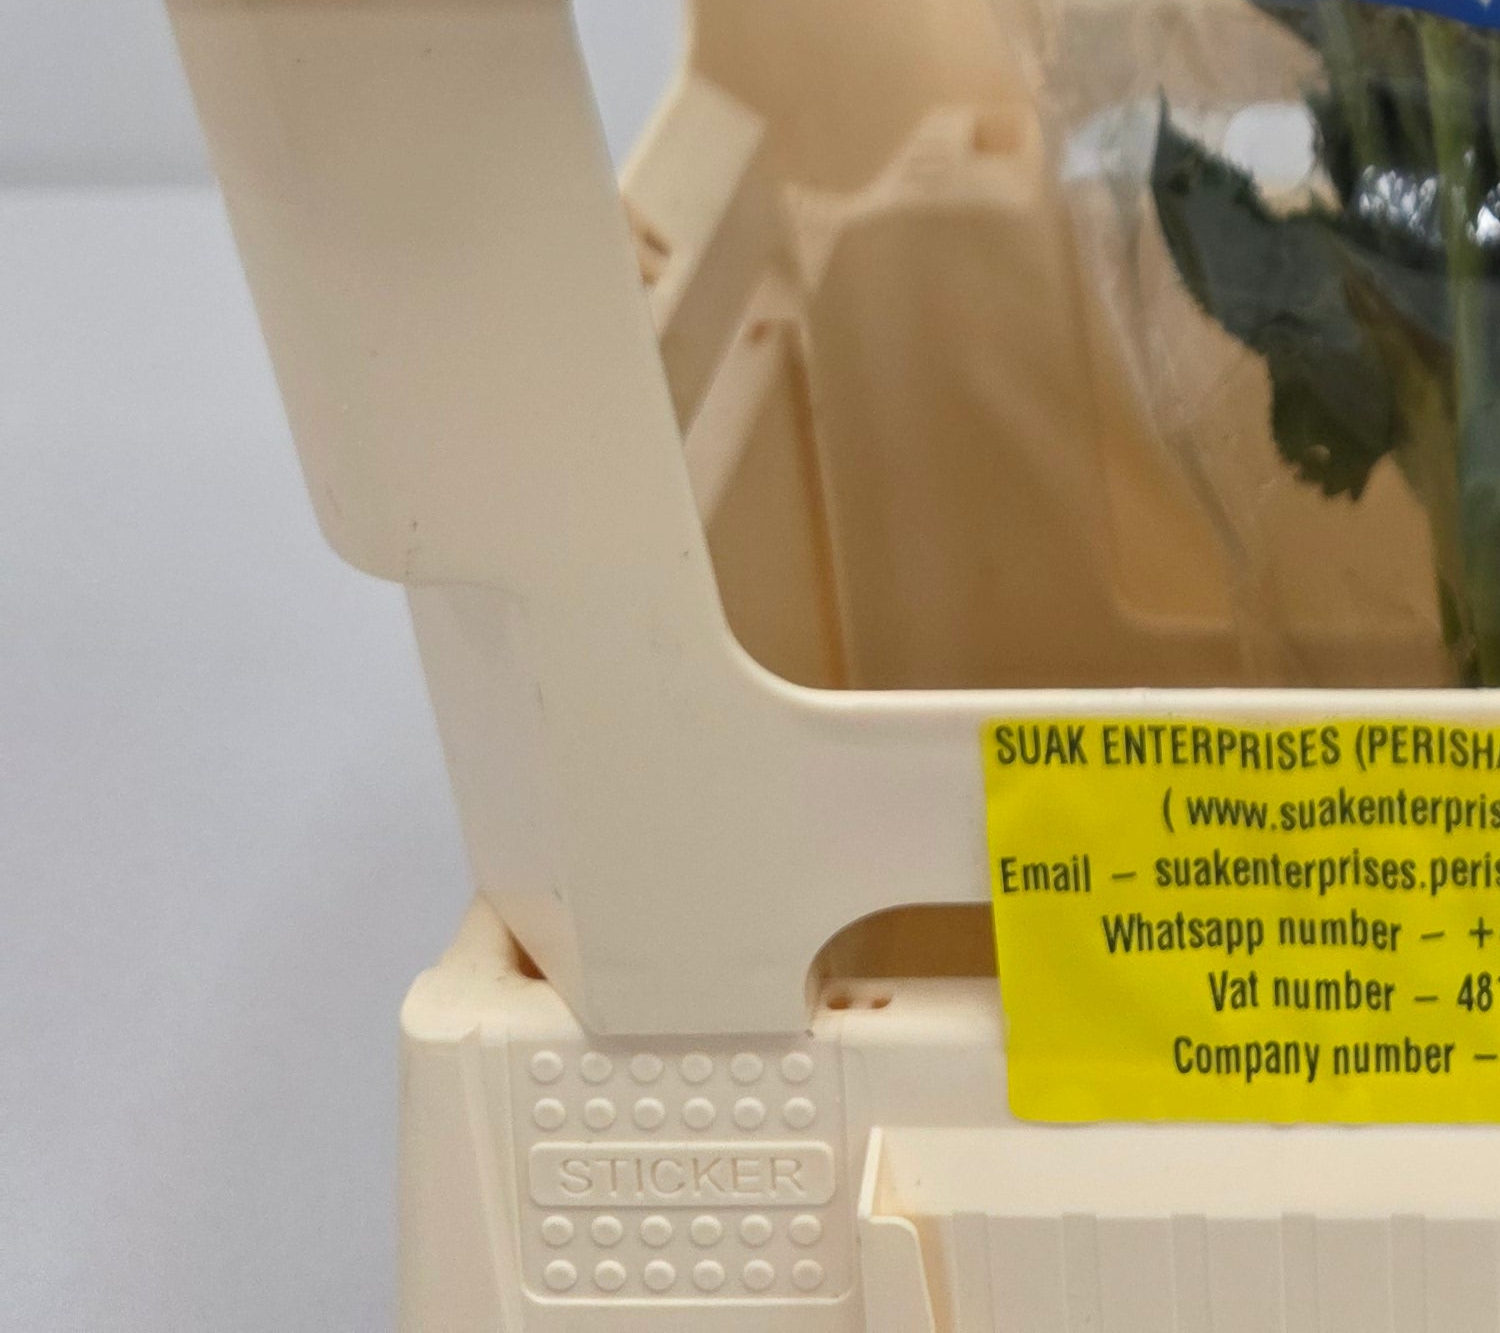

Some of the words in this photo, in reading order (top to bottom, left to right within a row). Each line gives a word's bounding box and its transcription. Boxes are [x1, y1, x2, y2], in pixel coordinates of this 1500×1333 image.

[995, 725, 1087, 767] SUAK
[1103, 726, 1341, 771] ENTERPRISES
[1000, 855, 1091, 896] Email
[1101, 912, 1264, 955] Whatsapp
[1278, 909, 1401, 952] number
[1208, 971, 1259, 1012] Vat
[1273, 970, 1395, 1012] number
[1173, 1037, 1318, 1083] Company
[1333, 1036, 1455, 1075] number
[559, 1156, 805, 1197] STICKER
